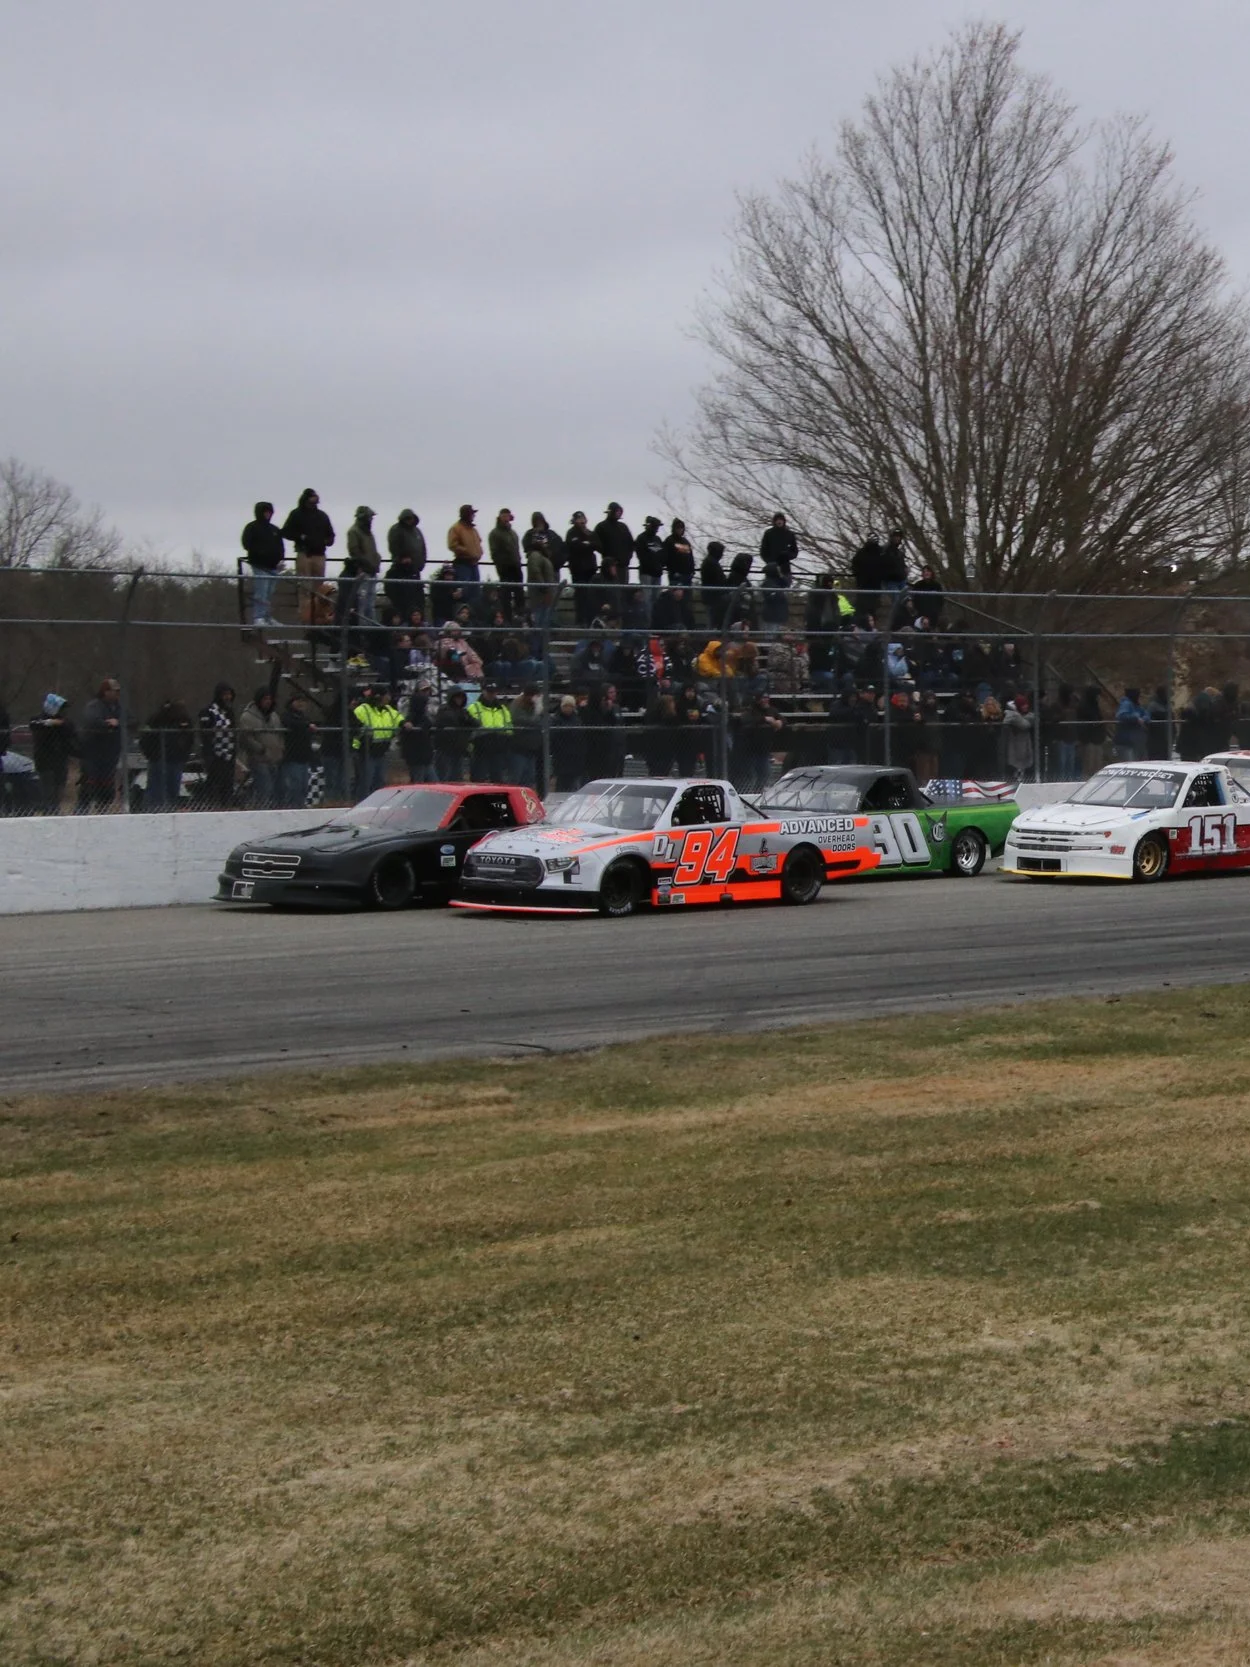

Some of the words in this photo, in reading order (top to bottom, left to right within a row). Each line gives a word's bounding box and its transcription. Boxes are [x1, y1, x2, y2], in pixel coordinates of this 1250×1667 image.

[780, 818, 855, 835] ADVANCED
[818, 834, 856, 844] OVERHEAD
[1188, 812, 1238, 856] 151
[832, 843, 856, 853] DOORS
[480, 856, 516, 865] TOYOTA
[674, 826, 743, 886] 94
